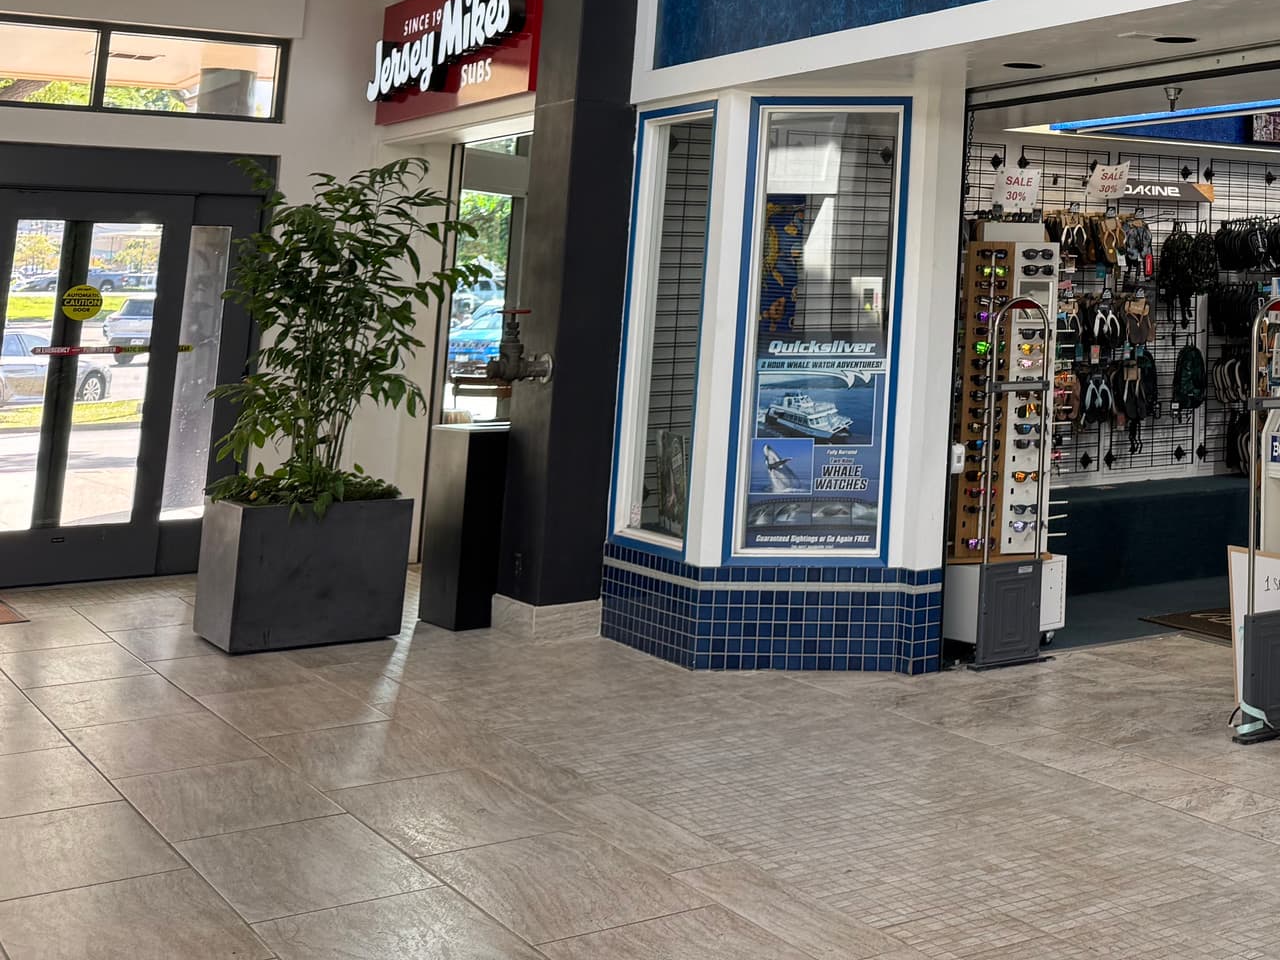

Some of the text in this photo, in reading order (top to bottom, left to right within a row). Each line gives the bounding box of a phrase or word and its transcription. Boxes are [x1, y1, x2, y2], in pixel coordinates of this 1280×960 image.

[403, 8, 443, 36] SINCE 19
[366, 39, 436, 102] Jersey
[460, 57, 493, 88] SUBS
[1005, 175, 1033, 187] SALE
[1100, 170, 1124, 181] SALE
[1006, 191, 1026, 201] 30%
[768, 340, 876, 356] Quicksilver
[787, 361, 810, 369] WHALE
[812, 361, 835, 369] WATCH
[836, 360, 882, 368] ADVENTURES!
[822, 465, 862, 477] WHALE
[815, 478, 868, 490] WATCHES
